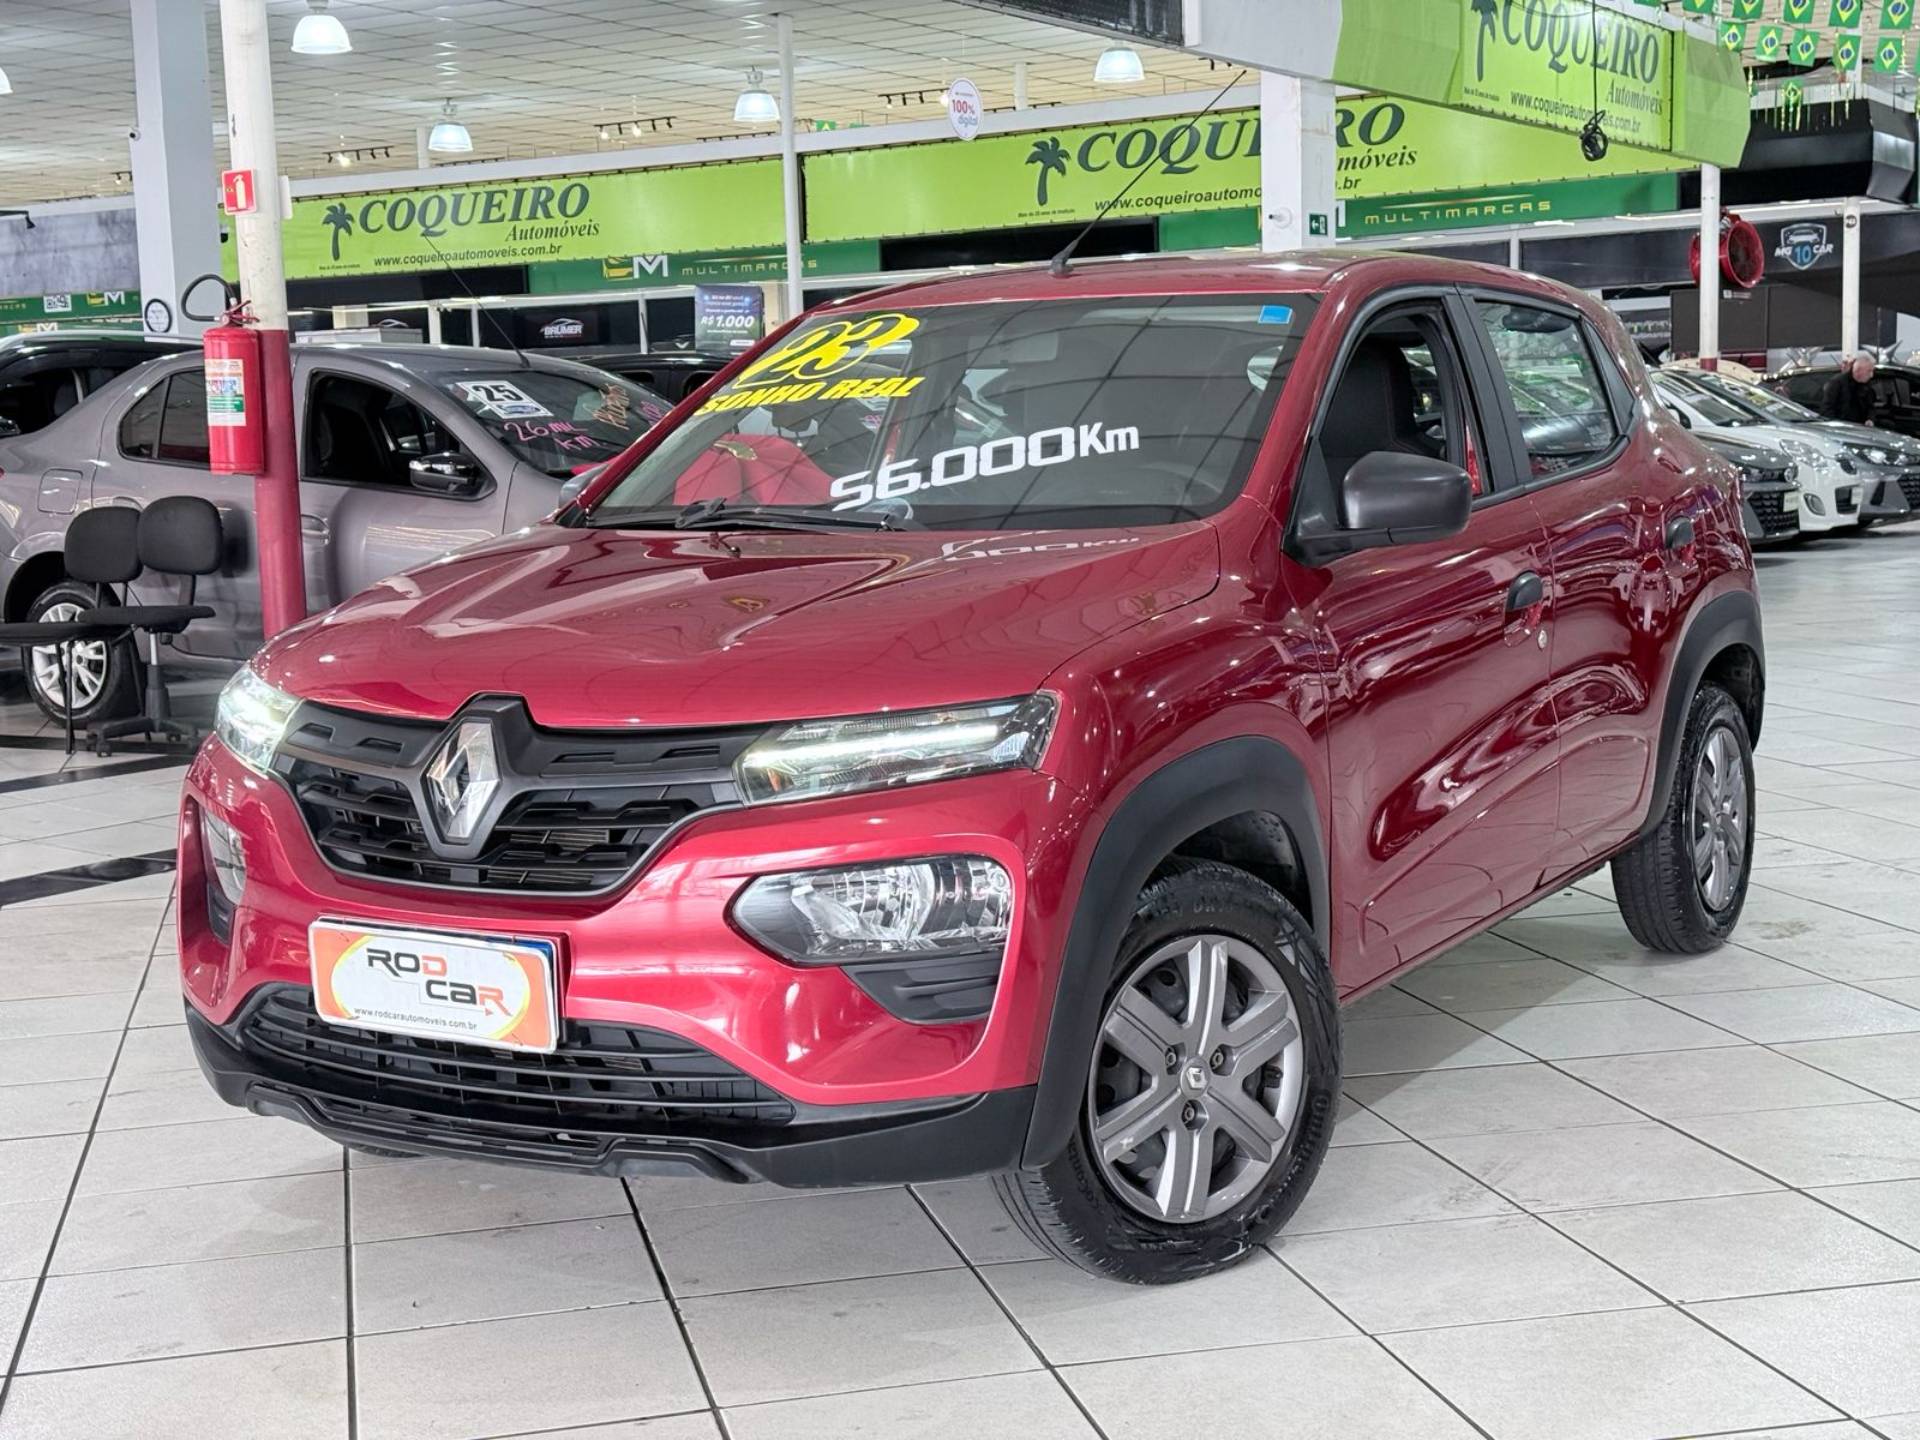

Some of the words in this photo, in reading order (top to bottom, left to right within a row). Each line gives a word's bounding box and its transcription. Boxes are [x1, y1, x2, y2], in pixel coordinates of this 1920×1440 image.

[1503, 0, 1659, 83] COQUEIRO
[952, 99, 976, 115] 100%
[1606, 79, 1663, 115] Automóveis
[359, 182, 590, 237] COQUEIRO
[1364, 201, 1551, 225] MULTIMARCAS
[505, 219, 600, 242] Automóveis
[374, 243, 563, 267] www.coqueiroautomoveis.com.br
[1795, 245, 1811, 263] 10
[1813, 244, 1834, 254] CAR
[732, 313, 920, 389] 23
[472, 385, 523, 402] 25
[694, 382, 827, 416] SONHO
[819, 377, 925, 399] REAL
[504, 421, 549, 441] 26
[366, 948, 447, 978] ROD
[354, 1007, 477, 1030] www.rodcarautomoveis.com.br
